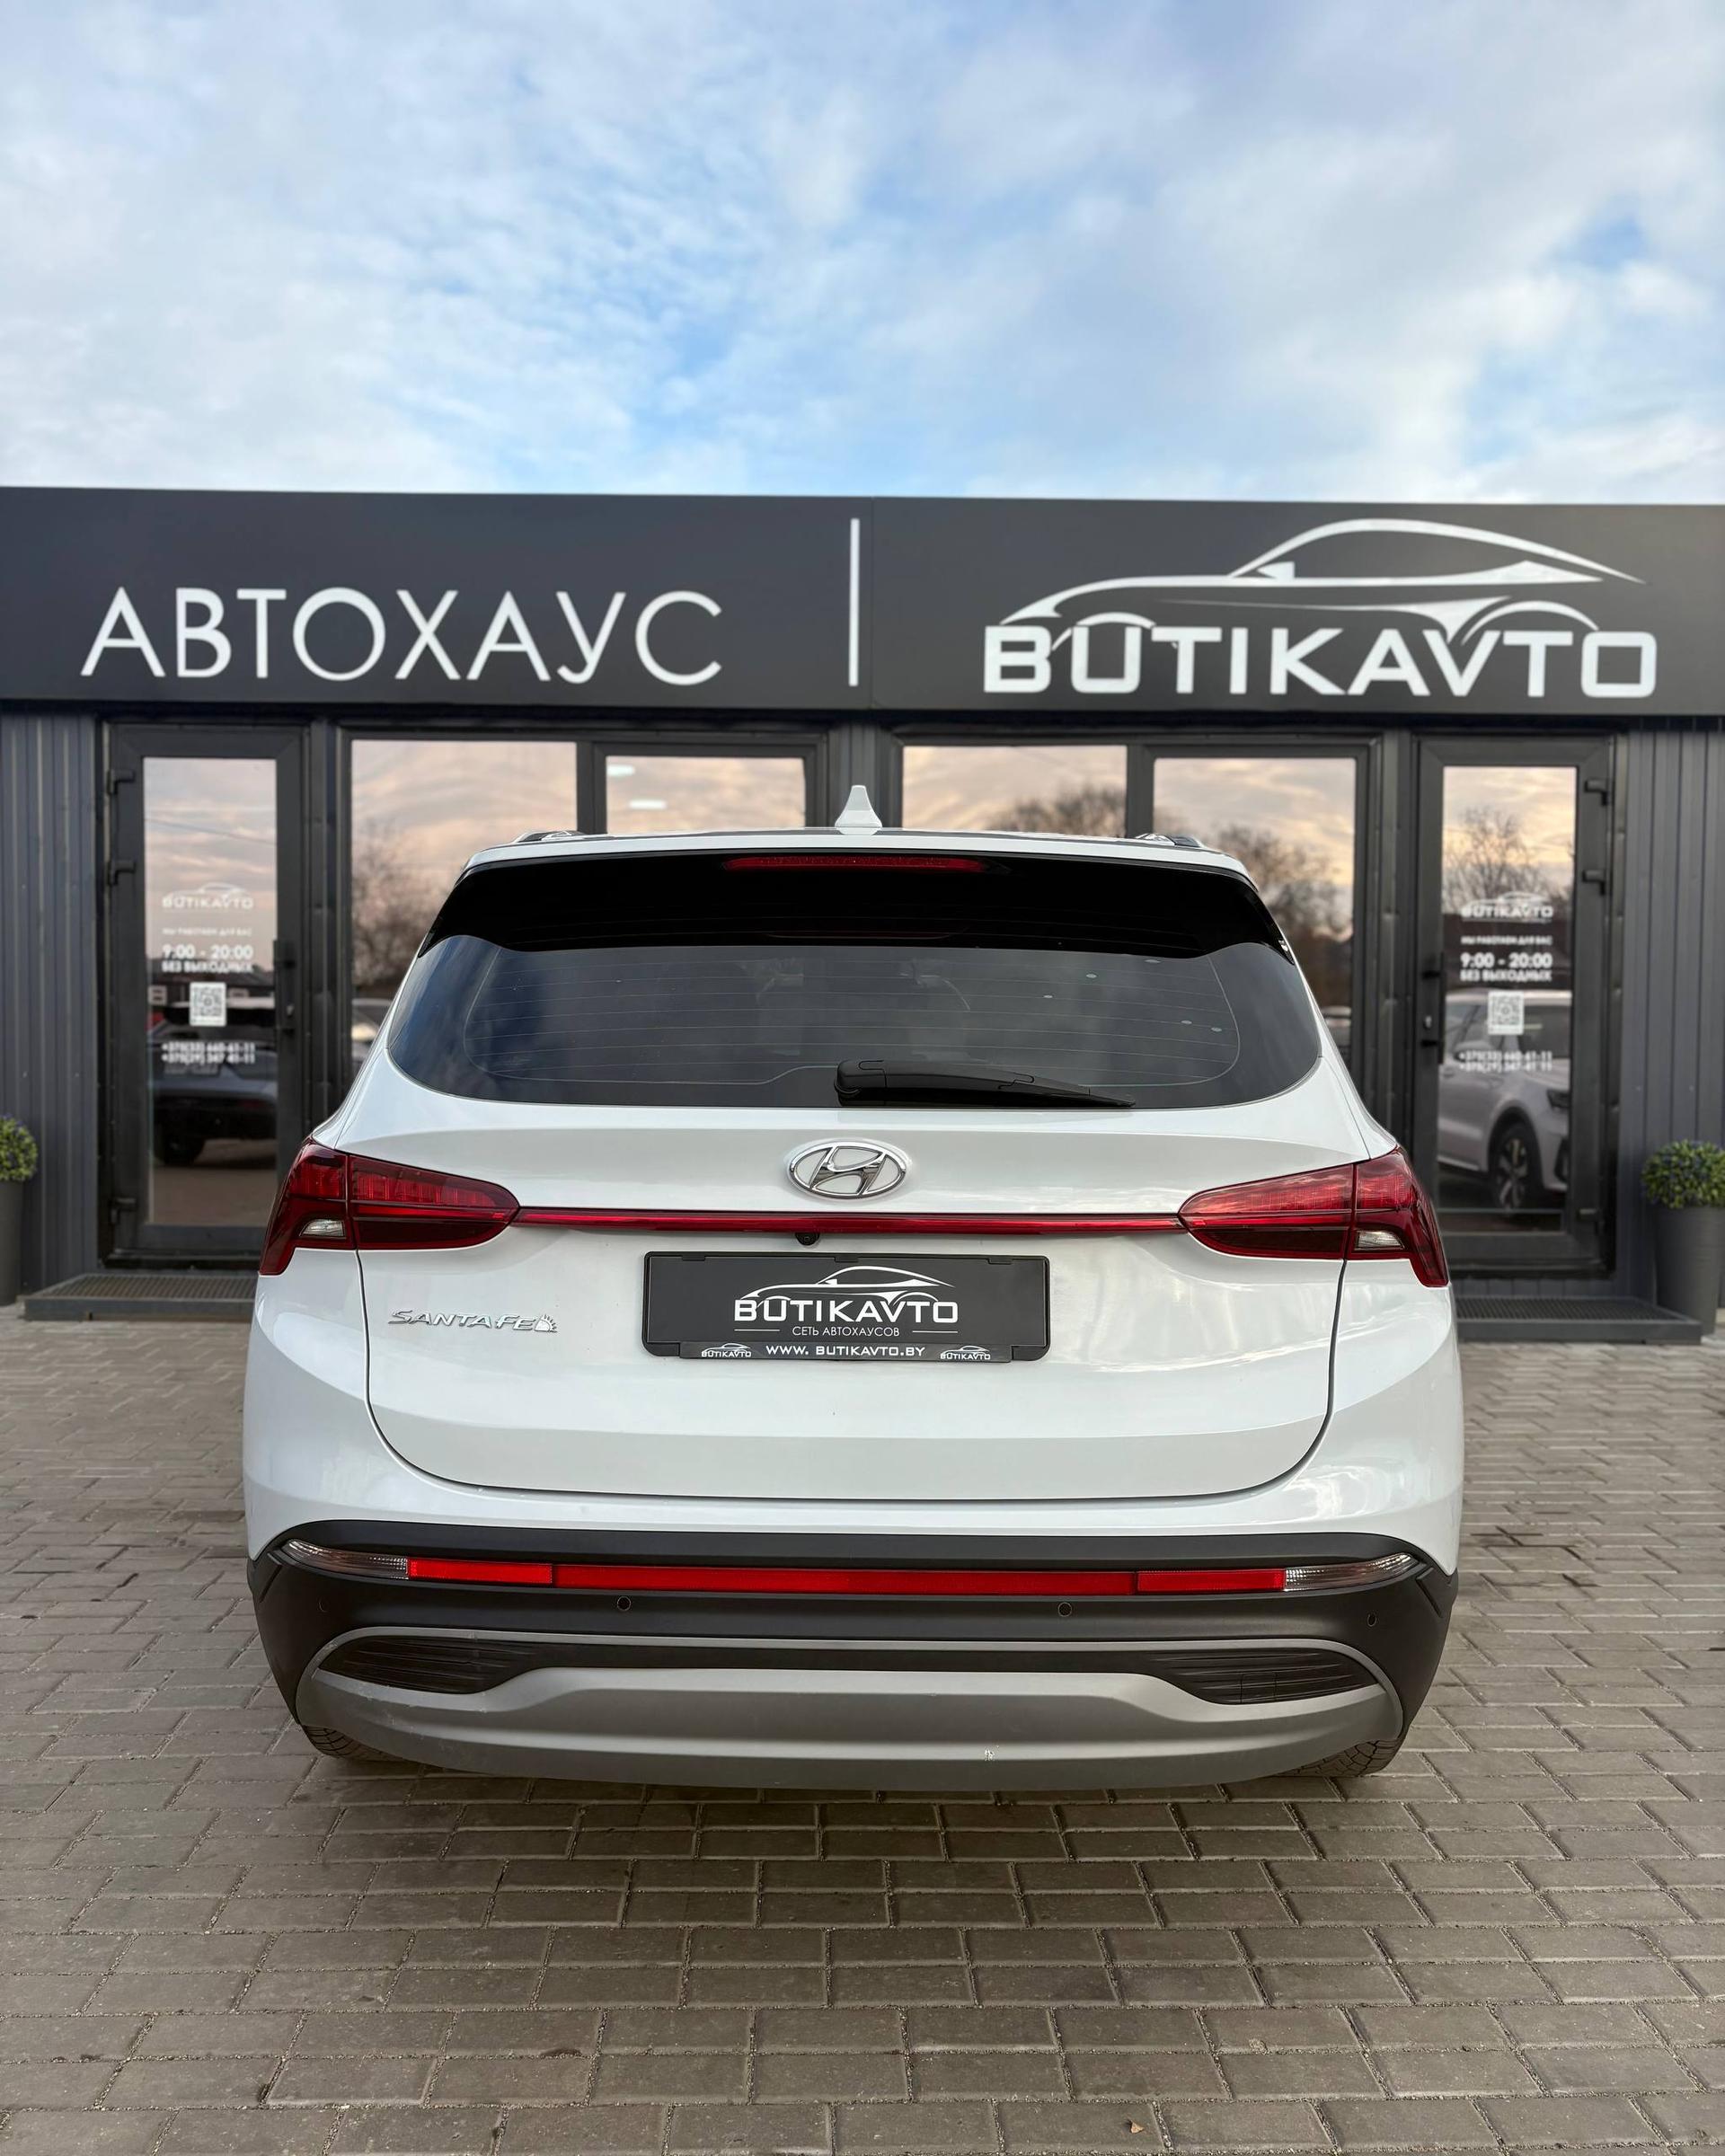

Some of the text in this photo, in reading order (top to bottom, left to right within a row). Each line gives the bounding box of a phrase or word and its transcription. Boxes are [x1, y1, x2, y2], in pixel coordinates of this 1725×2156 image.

[80, 587, 721, 686] АВТОХАУС
[983, 626, 1657, 698] BUTIKAVTO
[163, 897, 253, 909] BUTIKAVTO
[1461, 905, 1553, 918] BUTIKAVTO
[163, 944, 195, 959] 9:00
[211, 944, 253, 960] 20:00
[1460, 952, 1495, 968] 9:00
[1508, 952, 1553, 968] 20:00
[734, 1299, 959, 1323] BUTIKAVTO
[792, 1326, 900, 1337] СЕТЬ АВТОХАУСОВ
[816, 1346, 925, 1356] BUTIKAVTO.BY
